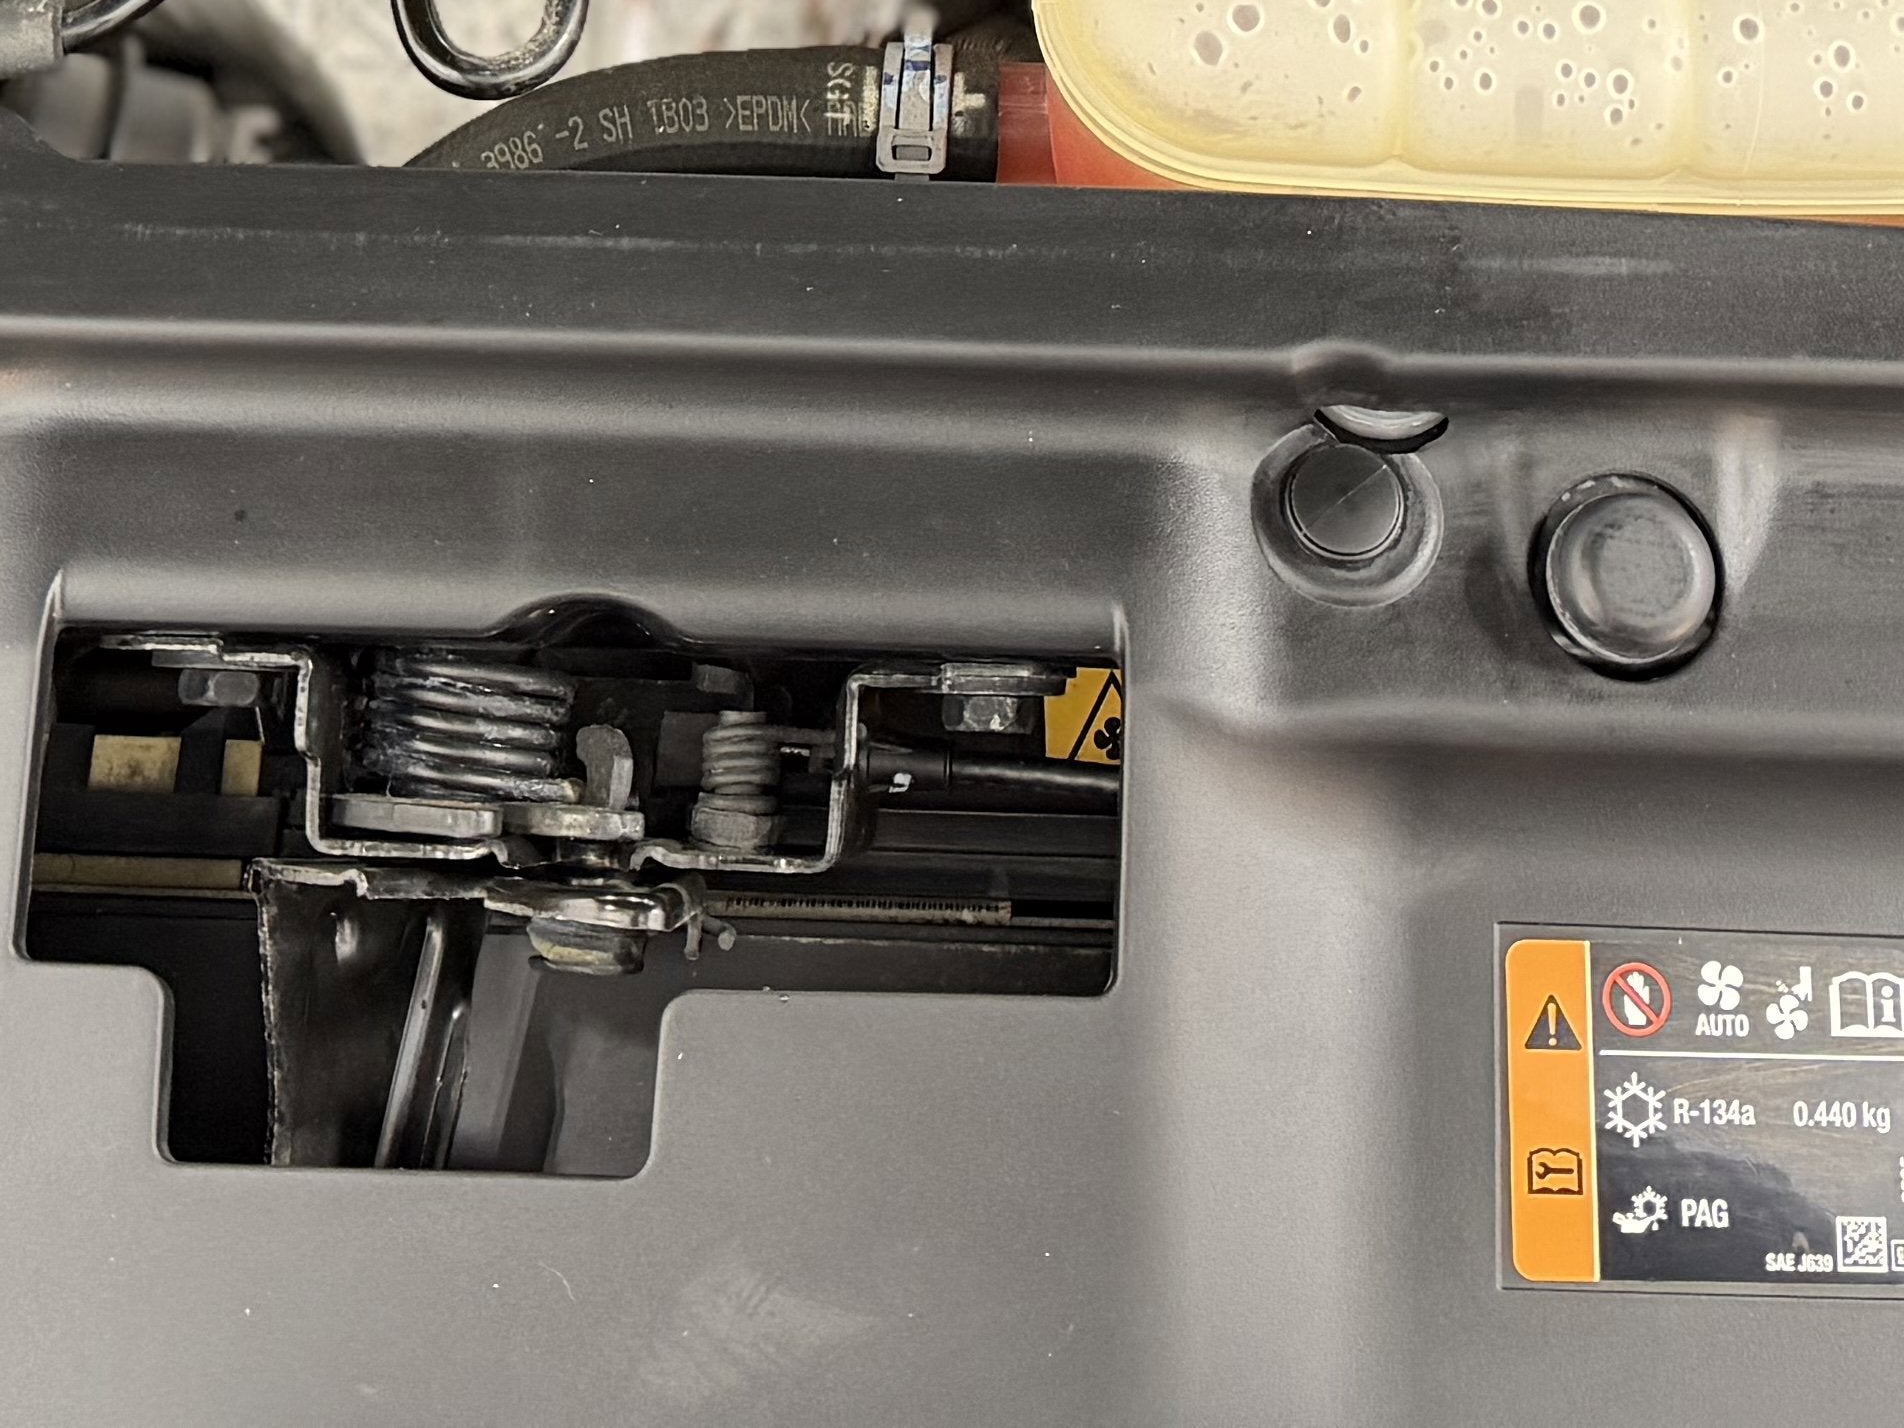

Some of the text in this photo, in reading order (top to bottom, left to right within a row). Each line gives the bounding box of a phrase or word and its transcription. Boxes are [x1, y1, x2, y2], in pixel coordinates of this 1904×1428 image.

[1695, 1013, 1750, 1038] AUTO
[1672, 1099, 1892, 1134] R-134a 0.440 kg
[1680, 1198, 1730, 1229] PAG
[1765, 1252, 1833, 1274] SAE J639
